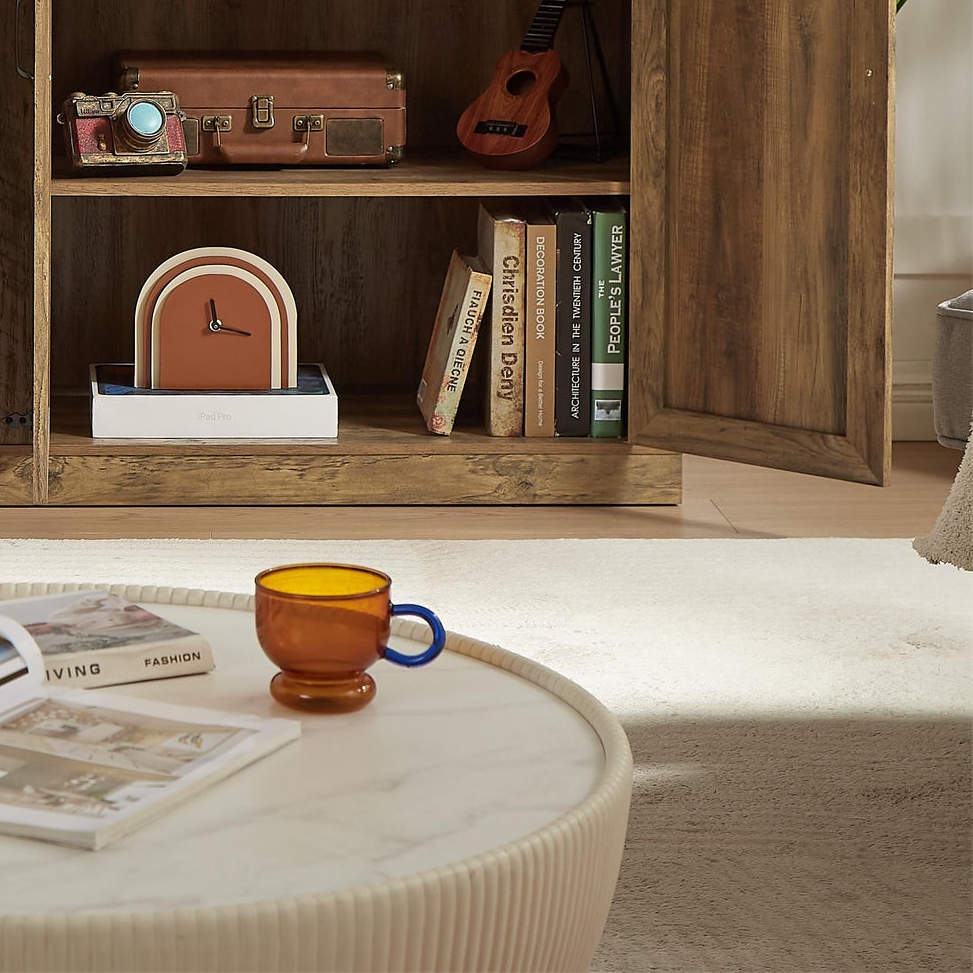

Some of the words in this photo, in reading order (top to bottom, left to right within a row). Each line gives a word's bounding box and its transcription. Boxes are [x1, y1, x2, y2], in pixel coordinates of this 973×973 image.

[536, 236, 545, 306] DECORATION
[573, 232, 582, 271] CENTURY
[609, 225, 624, 283] LAWYER
[462, 290, 482, 334] FIAUCH
[501, 255, 520, 345] Chrisdien
[572, 275, 582, 320] TWENTIETH
[458, 336, 469, 345] A
[536, 309, 545, 340] BOOK
[572, 323, 581, 340] THE
[608, 286, 623, 354] PEOPLE'S
[572, 343, 581, 353] IN
[497, 352, 518, 402] Deny
[571, 356, 581, 419] ARCHITECTURE
[197, 411, 216, 421] iPad
[218, 412, 232, 421] Pro
[45, 663, 101, 681] IVING
[144, 651, 201, 668] FASHION
